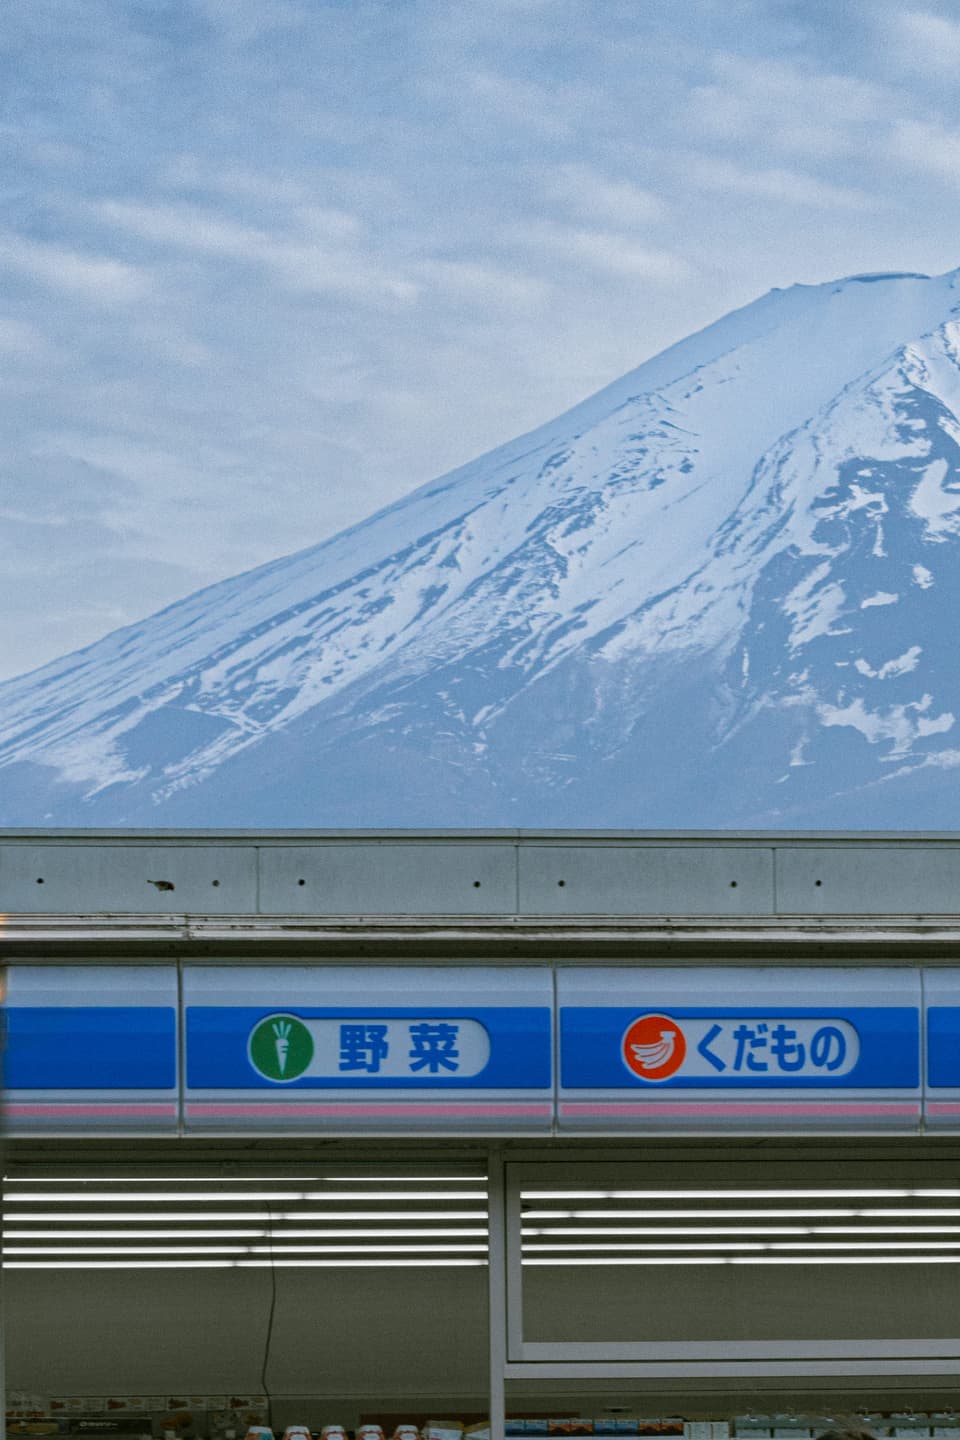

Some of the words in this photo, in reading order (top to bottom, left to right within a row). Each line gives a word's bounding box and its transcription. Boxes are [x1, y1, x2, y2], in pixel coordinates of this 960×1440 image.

[338, 1023, 460, 1073] 野菜
[696, 1023, 847, 1072] くだもの
